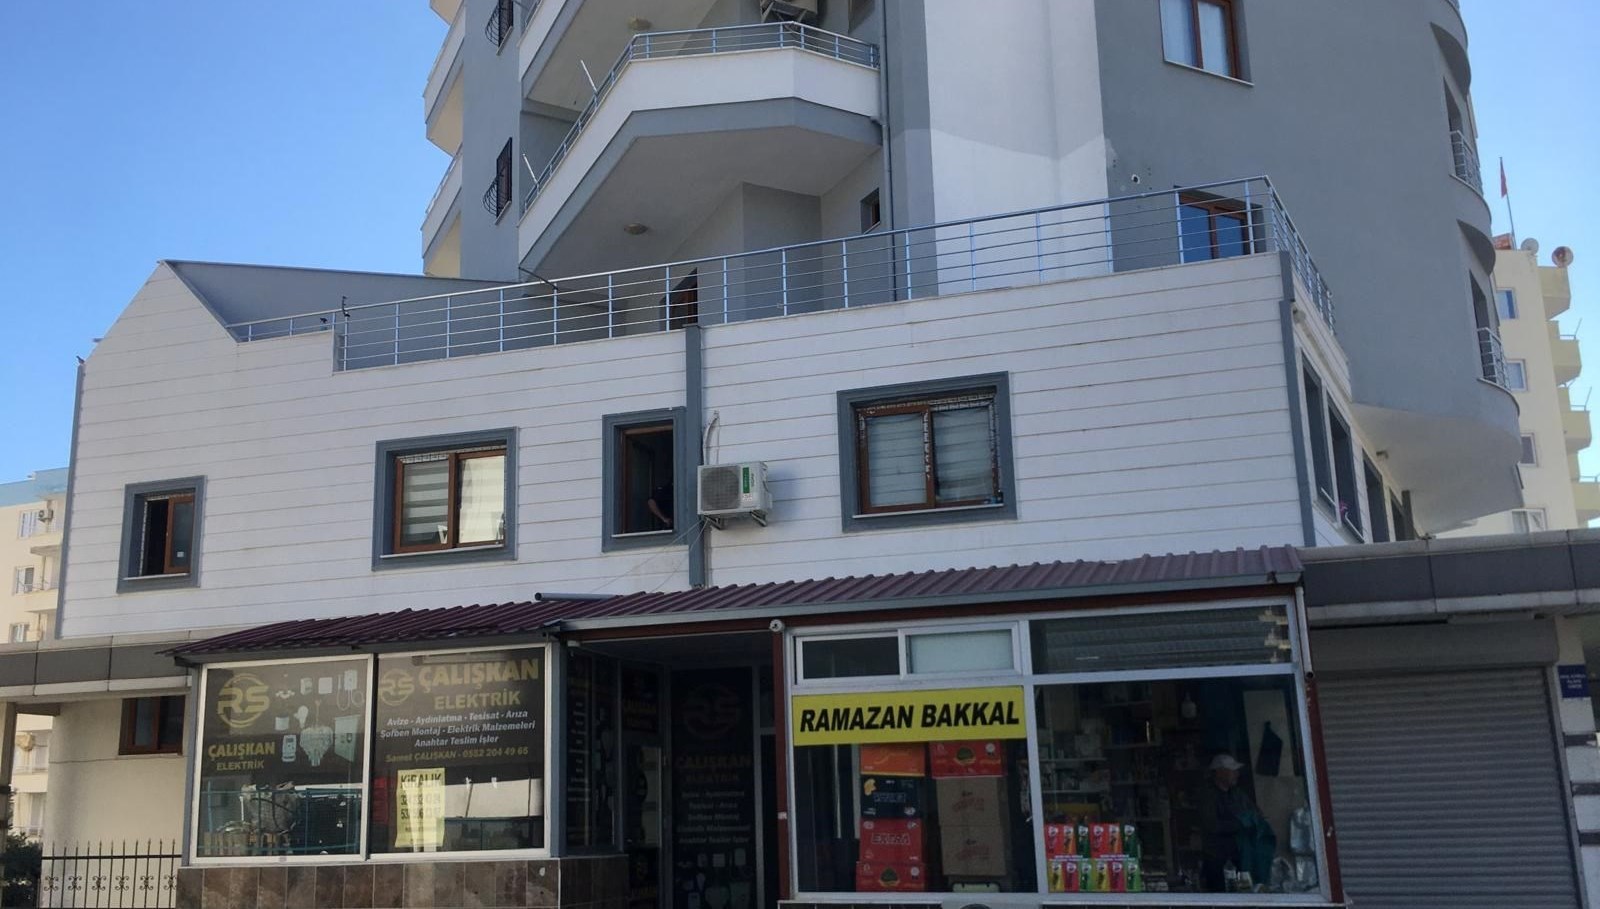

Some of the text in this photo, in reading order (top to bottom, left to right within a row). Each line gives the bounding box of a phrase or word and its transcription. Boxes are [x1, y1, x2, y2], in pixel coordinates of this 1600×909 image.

[418, 658, 539, 694] ÇALIŞKAN
[434, 689, 521, 711] ELEKTRİK
[506, 709, 528, 719] Arıza
[800, 701, 1020, 733] RAMAZAN BAKKAL
[447, 723, 481, 734] Elektrik
[414, 737, 449, 749] Anahtar
[450, 735, 478, 746] Teslim
[207, 741, 276, 761] ÇALIŞKAN
[217, 759, 264, 771] ELEKTRİK
